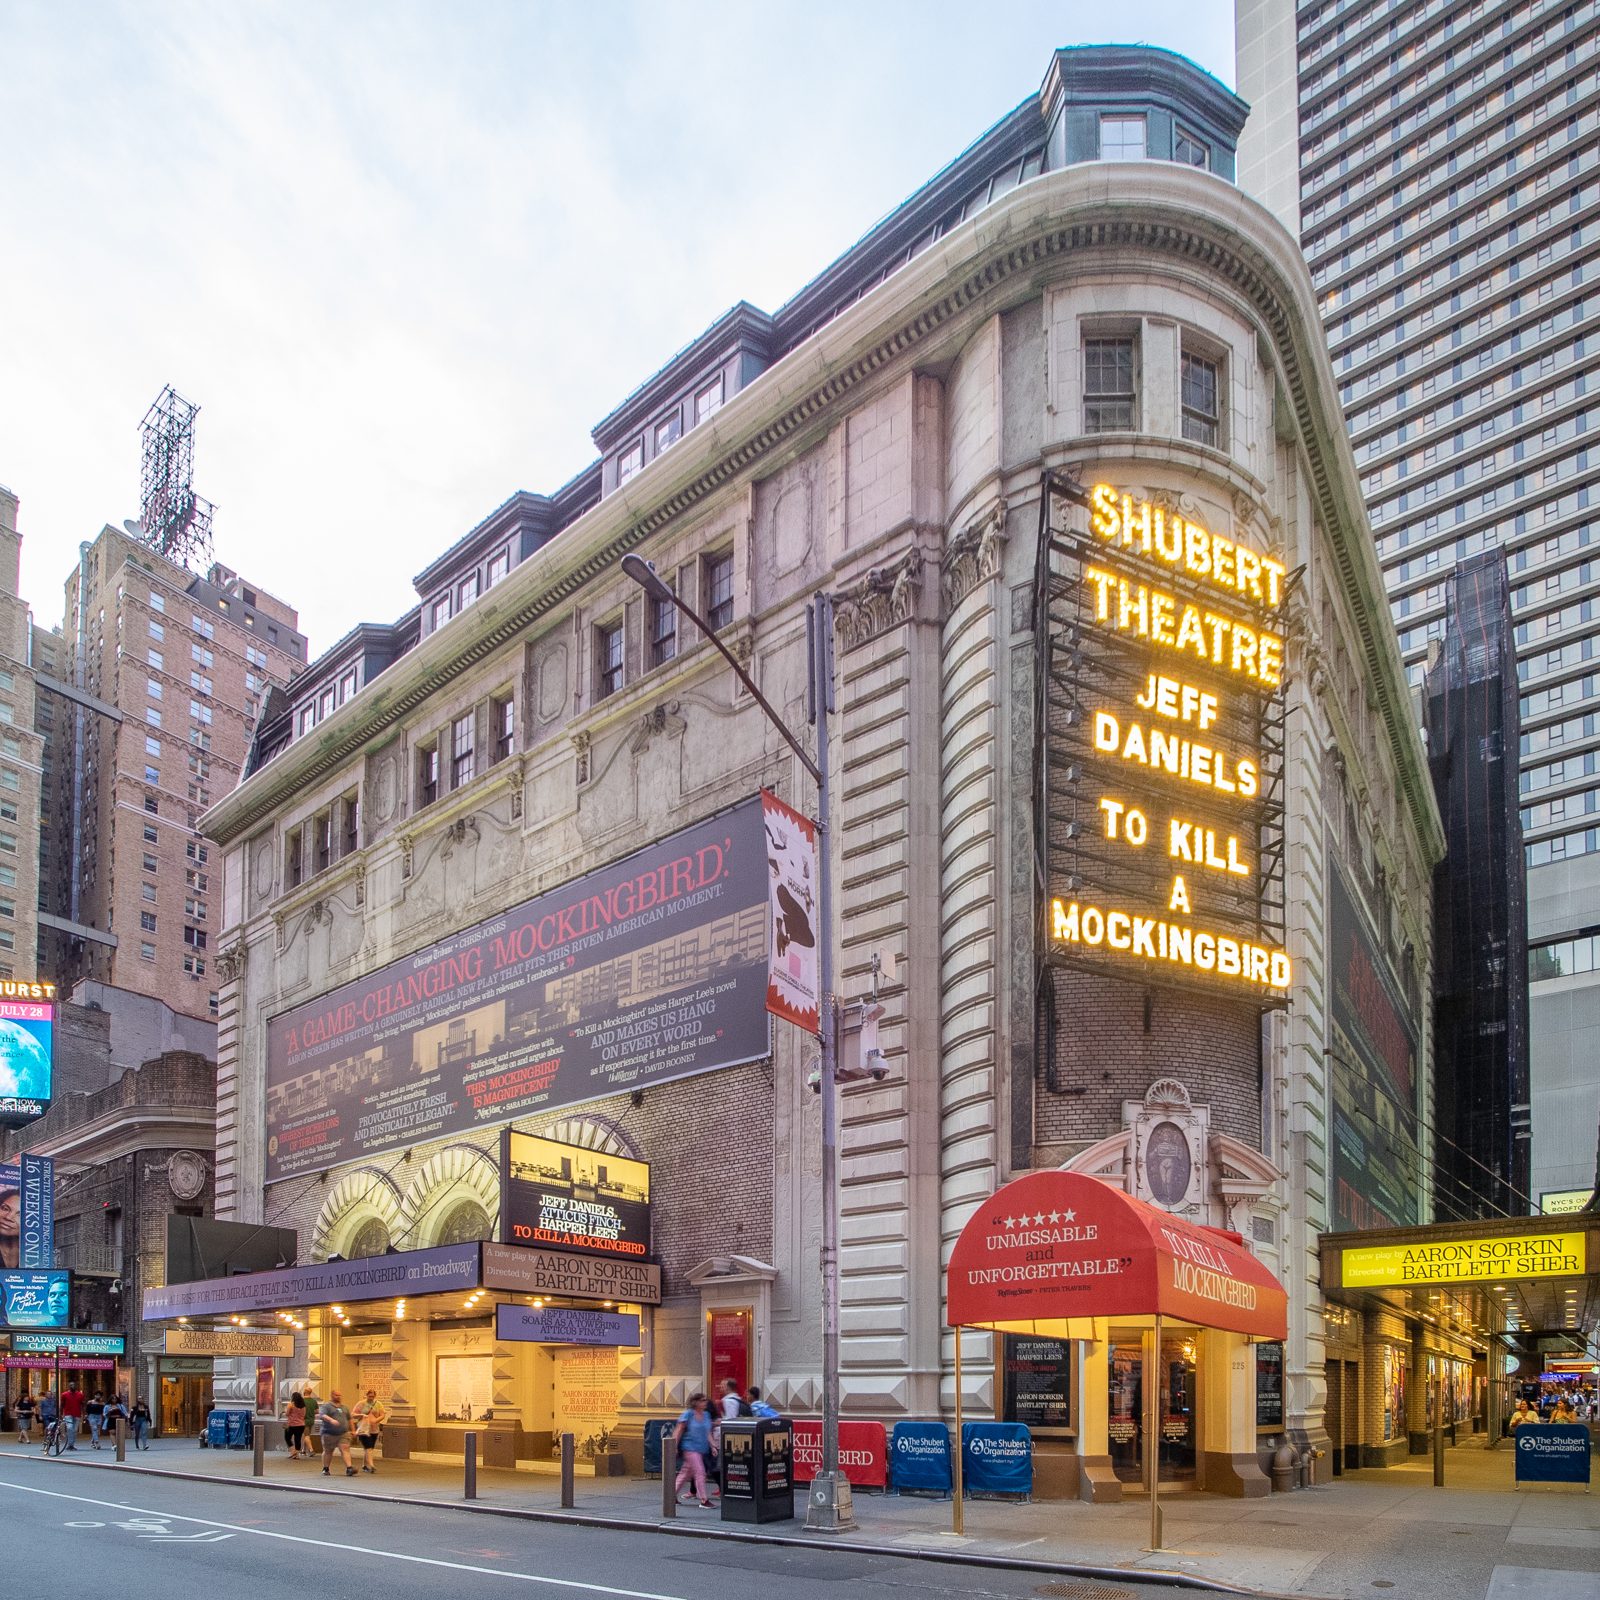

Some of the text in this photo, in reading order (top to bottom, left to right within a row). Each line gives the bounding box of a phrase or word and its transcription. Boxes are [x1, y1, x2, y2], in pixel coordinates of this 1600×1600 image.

[1092, 483, 1285, 606] SHUBERT
[1086, 565, 1282, 685] THEATRE
[1137, 674, 1217, 729] JEFF
[1094, 711, 1258, 797] DANIELS
[1100, 799, 1249, 875] TO KILL
[1170, 876, 1190, 912] A
[413, 919, 505, 970] Chicago Tribune CHRIS JONES
[1052, 900, 1292, 988] MOCKINGBIRD
[288, 1049, 307, 1066] AARON
[344, 1023, 373, 1043] WRITTEN
[374, 1020, 379, 1031] A
[380, 1003, 421, 1029] GENUINELY
[422, 989, 454, 1012] RADICAL
[456, 980, 476, 998] NEW
[477, 971, 500, 991] PLAY
[500, 962, 523, 981] THAT
[525, 953, 545, 971] FITS
[547, 943, 569, 963] THIS
[571, 930, 603, 953] RIVEN
[605, 905, 664, 940] AMERICAN
[666, 881, 724, 916] MOMENT.
[303, 947, 483, 1048] GAME-CHANGING
[585, 1023, 596, 1035] Kill
[647, 1000, 666, 1015] takes
[668, 991, 694, 1010] Harper
[695, 985, 714, 1000] Lee's
[716, 978, 737, 995] novel
[30, 1007, 43, 1017] 28
[590, 998, 716, 1048] AND MAKES US HANG
[2, 1034, 16, 1043] the
[601, 1019, 701, 1060] ON EVERY WORD
[645, 1061, 664, 1073] DAVID
[666, 1052, 695, 1068] ROONEY
[465, 1080, 486, 1096] THIS
[359, 1100, 420, 1128] PROVOCATIVELY
[420, 1091, 446, 1109] FRESH
[474, 1095, 482, 1108] IS
[354, 1128, 368, 1141] AND
[370, 1114, 415, 1137] RUSTICALLY
[25, 1160, 40, 1268] 16 WEEKS ONLY
[539, 1194, 614, 1216] JEFF DANIELS
[539, 1206, 621, 1230] ATTICUS FINCH
[514, 1225, 646, 1255] TO KILL A MOCKINGBIRD
[539, 1217, 618, 1240] HARPER LEE'S
[986, 1225, 1098, 1251] UNMISSABLE
[42, 1226, 50, 1268] ENGAGEMEN
[1025, 1246, 1054, 1261] and
[1160, 1228, 1232, 1274] TO KILL A
[1376, 1252, 1392, 1261] play
[1394, 1251, 1404, 1259] by
[1402, 1245, 1473, 1263] AARON
[1479, 1239, 1563, 1258] SORKIN
[486, 1248, 649, 1282] A new play by AARON SORKIN
[1349, 1256, 1579, 1280] Directed by BARTLETT SHER
[197, 1291, 210, 1303] FOR
[212, 1290, 225, 1301] THE
[227, 1286, 259, 1300] MIRACLE
[260, 1285, 279, 1297] THAT
[281, 1284, 289, 1294] IS
[306, 1277, 326, 1291] KILL
[328, 1277, 335, 1289] A
[408, 1269, 420, 1280] on
[486, 1266, 659, 1300] Directed by BARTLETT SHER
[1172, 1258, 1256, 1311] MOCKINGBIRD
[522, 1316, 620, 1330] SOARS AS A TOWERING
[540, 1325, 576, 1335] ATTICUS
[16, 1336, 120, 1346] BROADWAY'S ROMANTIC
[69, 1344, 109, 1352] RETURNS!
[1232, 1362, 1245, 1370] 225
[908, 1437, 944, 1447] The Shubert
[908, 1446, 945, 1455] Organization
[983, 1438, 1026, 1448] The Shubert
[983, 1447, 1026, 1457] Organization
[1536, 1437, 1585, 1445] The Shubert
[1536, 1444, 1585, 1453] Organization
